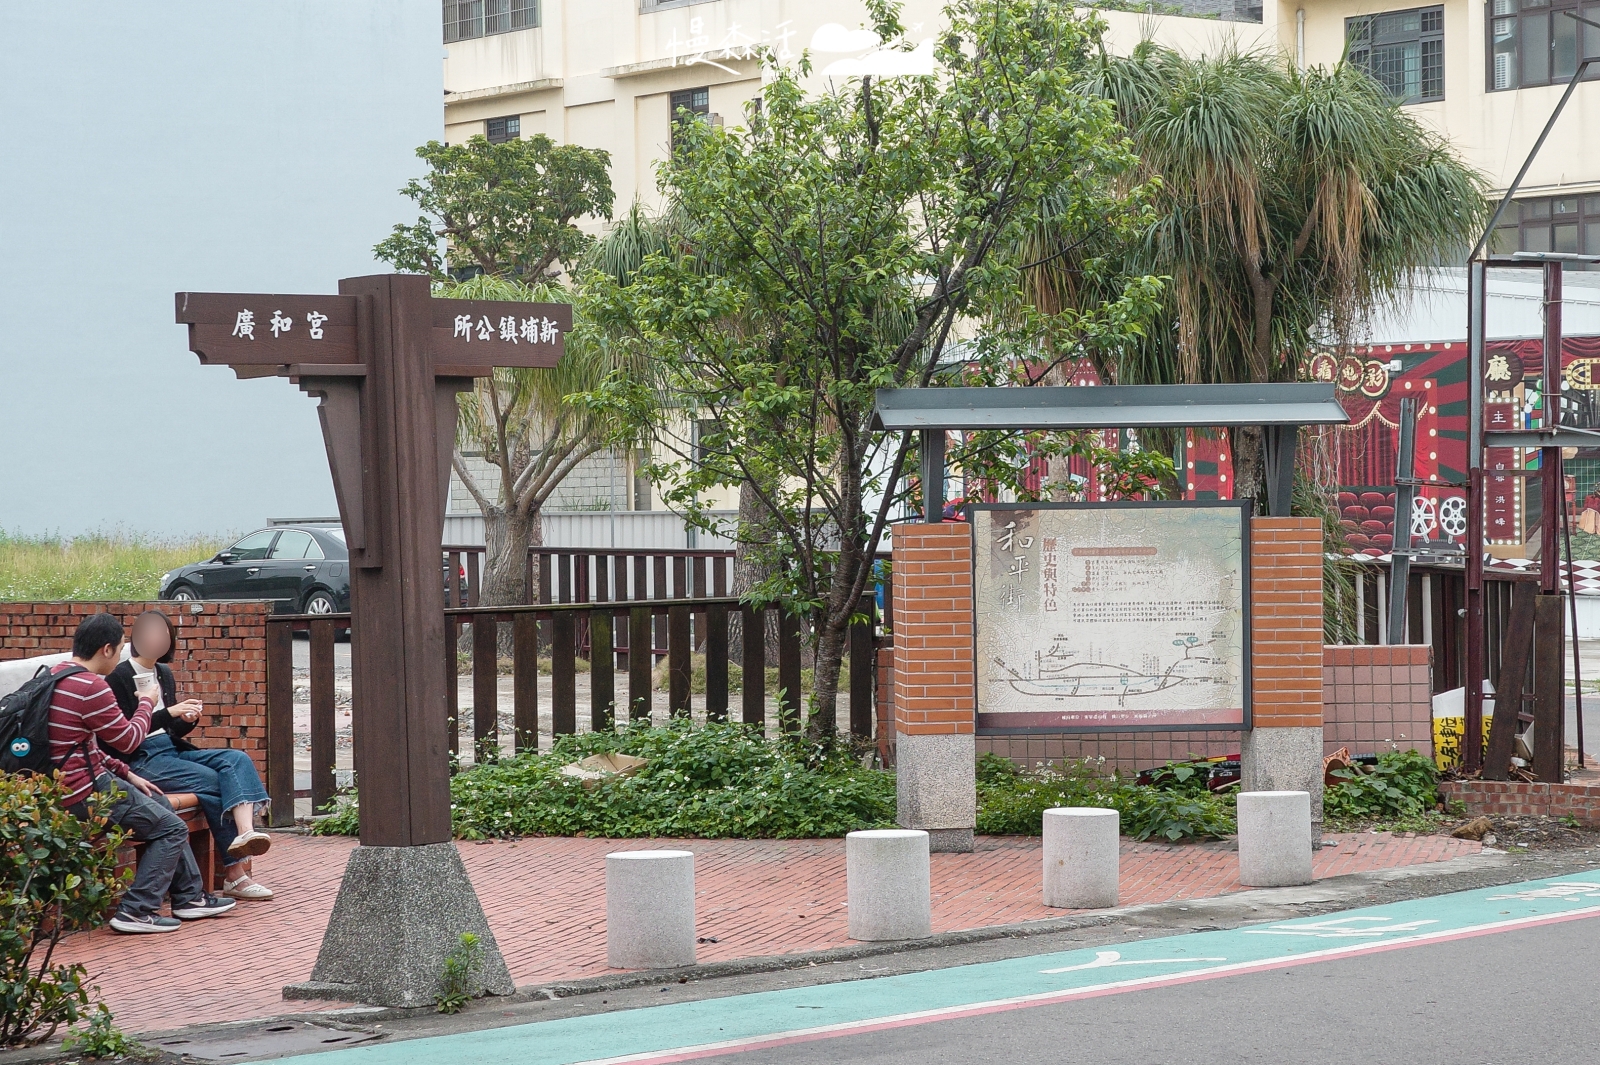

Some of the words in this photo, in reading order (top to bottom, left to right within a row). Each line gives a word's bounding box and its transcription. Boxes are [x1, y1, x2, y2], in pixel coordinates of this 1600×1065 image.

[231, 308, 329, 341] 廣和宮
[452, 313, 560, 346] 新埔鎮公所
[995, 520, 1035, 613] 和平街
[1042, 537, 1058, 612] 歷史與特色
